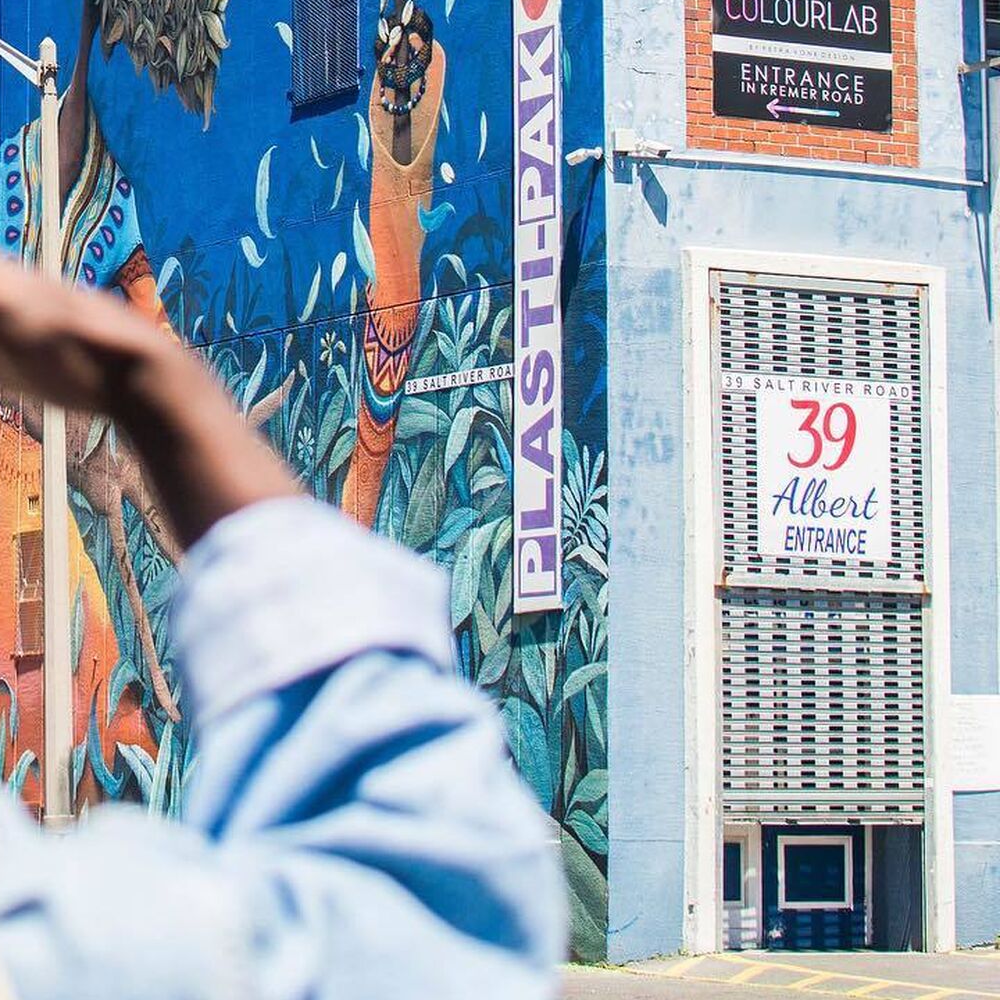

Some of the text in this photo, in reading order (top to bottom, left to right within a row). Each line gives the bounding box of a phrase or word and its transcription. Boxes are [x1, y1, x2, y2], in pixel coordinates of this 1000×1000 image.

[741, 63, 864, 93] ENTRANCE
[741, 81, 864, 105] IN KREMER ROAD
[519, 27, 555, 594] PLASTI-PAK
[407, 365, 515, 393] 39 SALT RIVER ROA
[725, 376, 910, 398] 39 SALT RIVER ROAD
[787, 398, 857, 471] 39
[772, 476, 879, 520] Albert
[784, 525, 867, 555] ENTRANCE
